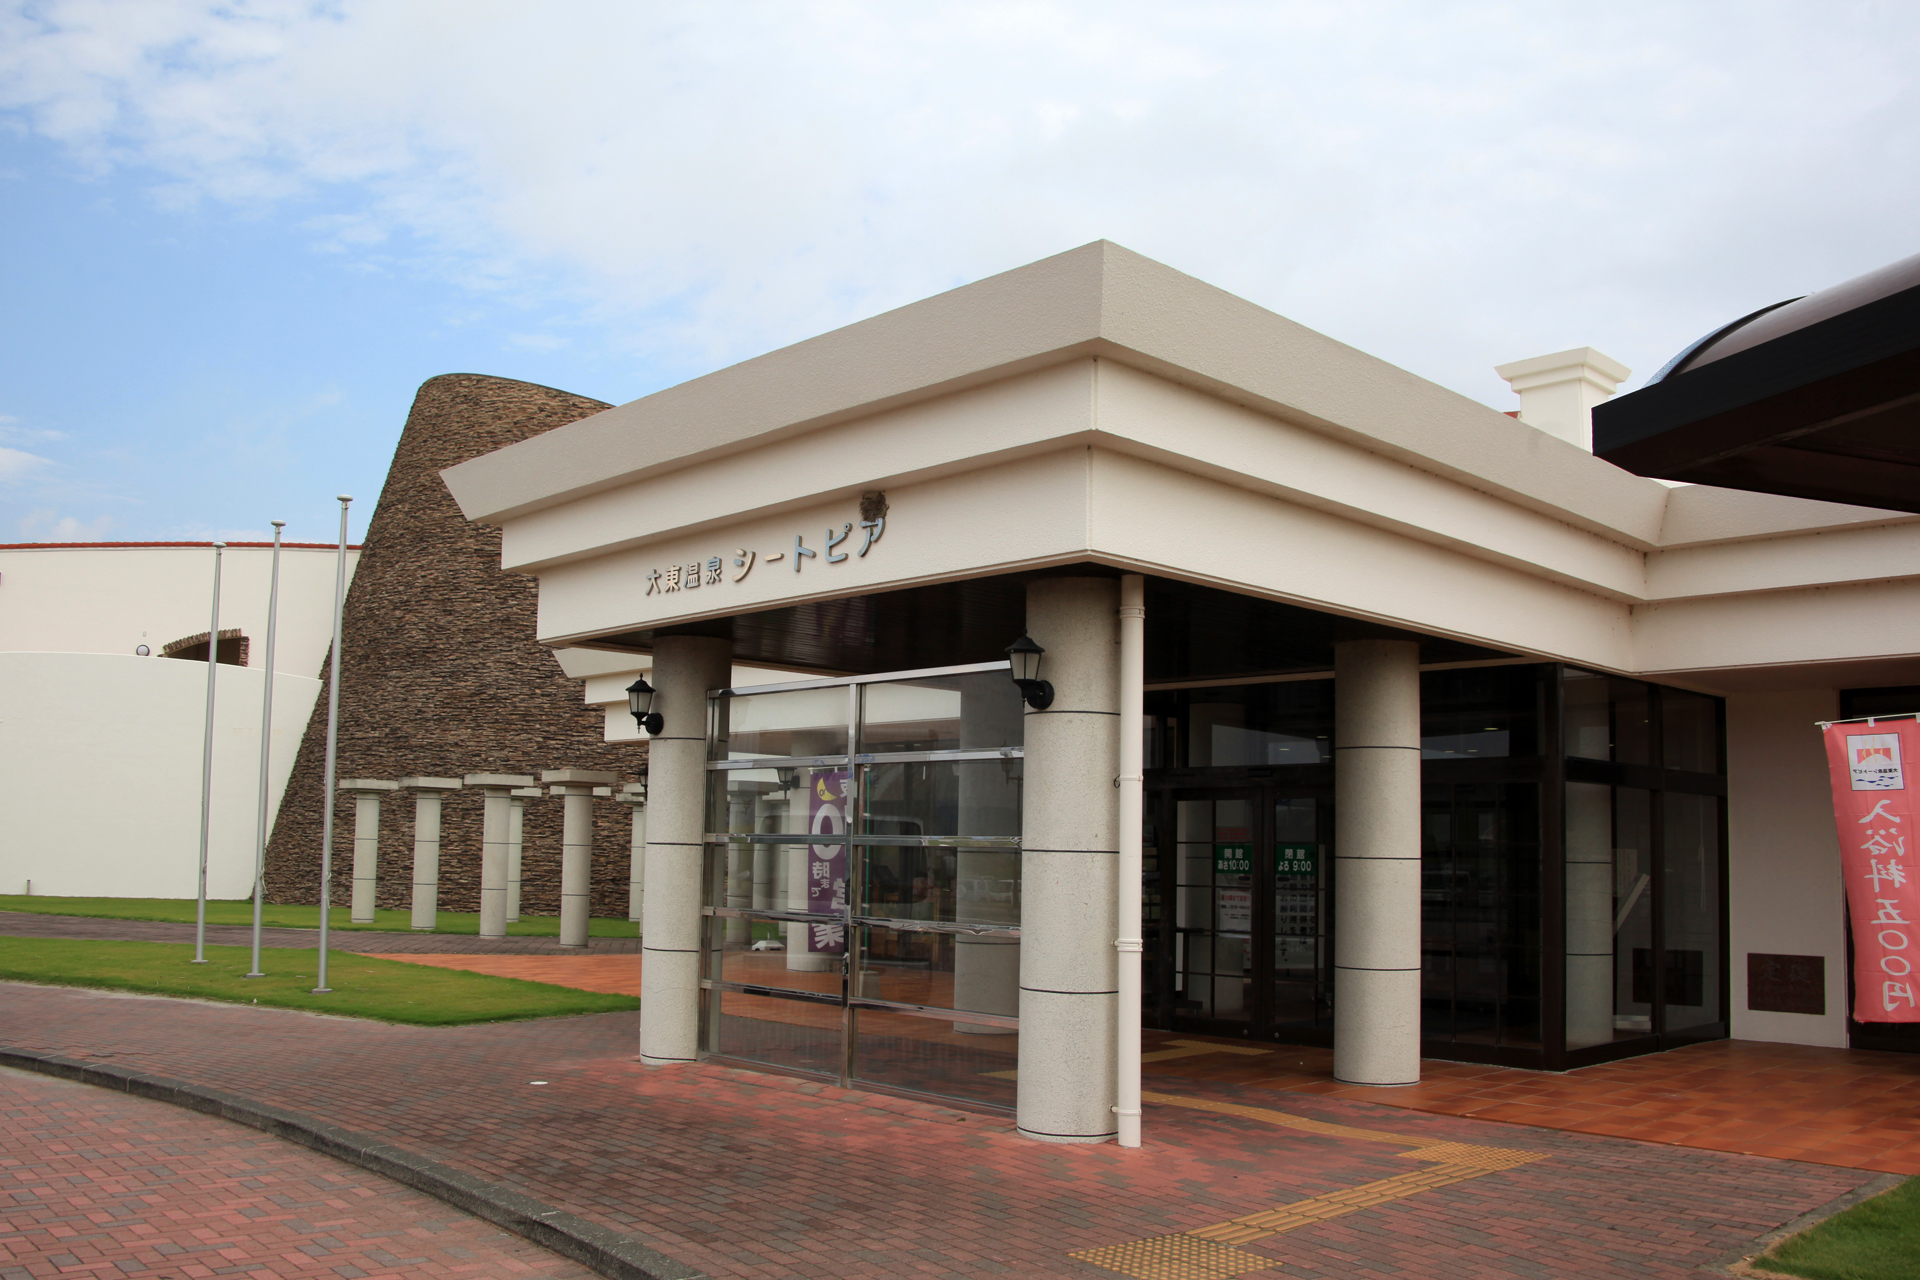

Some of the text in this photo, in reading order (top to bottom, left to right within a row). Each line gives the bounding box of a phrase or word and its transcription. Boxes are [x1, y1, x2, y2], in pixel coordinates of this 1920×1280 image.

[645, 517, 886, 596] 大東温泉 シートピア
[1224, 848, 1243, 859] 開館
[1285, 848, 1305, 860] 閉館
[1217, 860, 1250, 870] あさ10:00
[1278, 860, 1312, 871] よる 9:00
